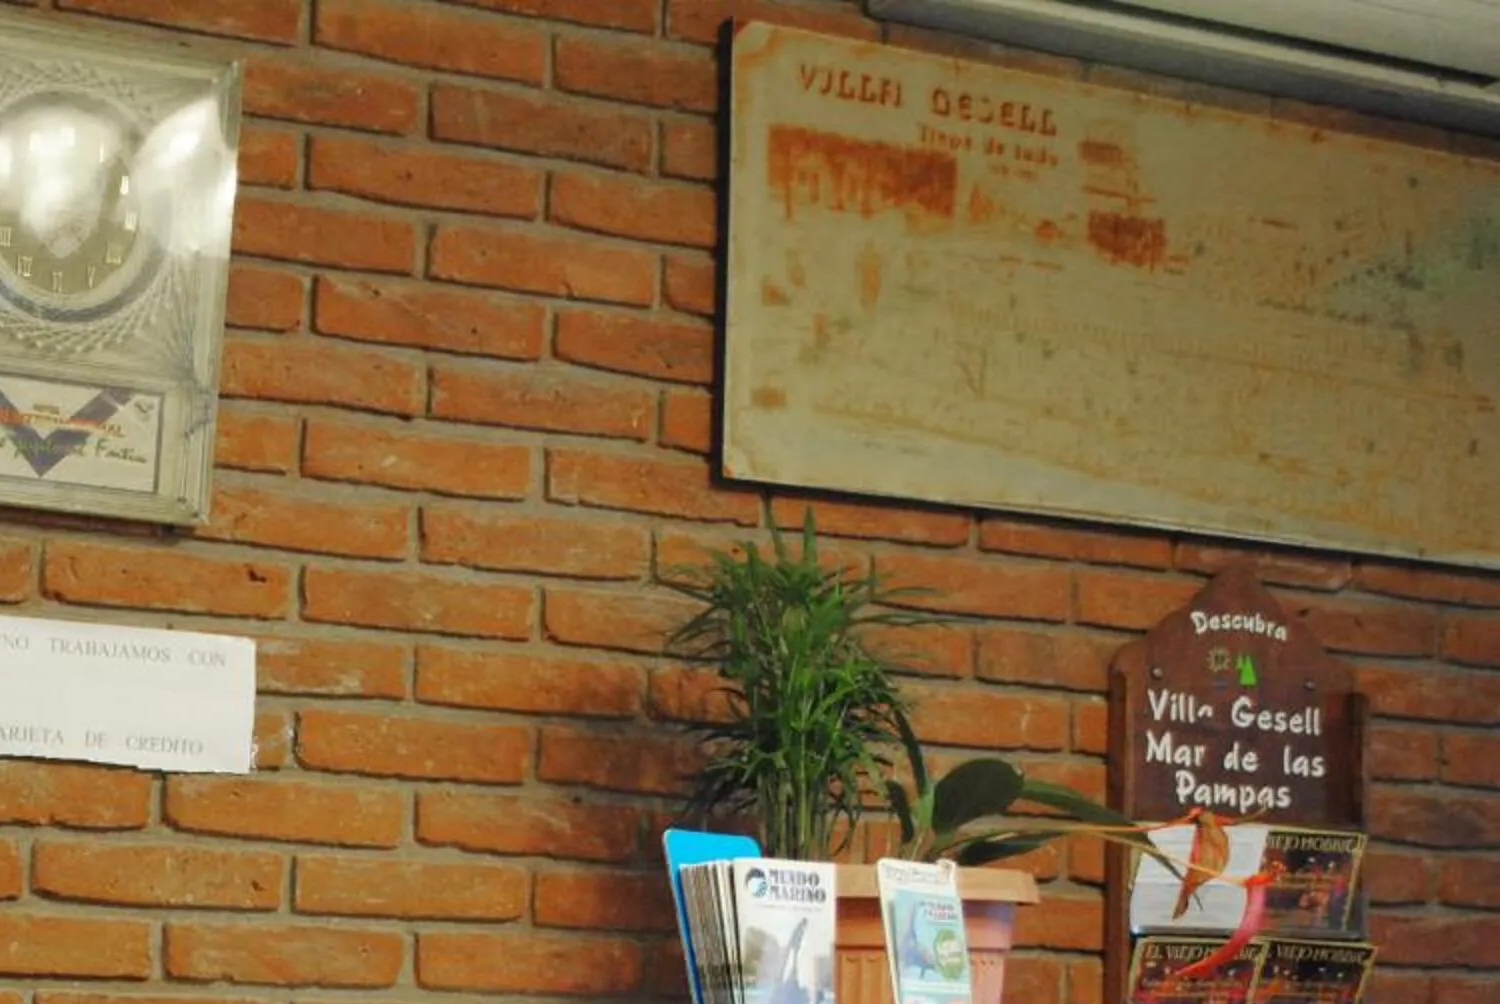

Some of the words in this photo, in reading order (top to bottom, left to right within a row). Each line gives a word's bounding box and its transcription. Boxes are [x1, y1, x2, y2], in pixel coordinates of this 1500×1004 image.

[1190, 610, 1288, 642] Descubra
[48, 636, 172, 664] TRABAJAMOS
[187, 650, 228, 668] CON
[1231, 695, 1323, 736] Gesell
[85, 730, 108, 748] DE
[125, 735, 204, 756] CREDITO
[1145, 730, 1205, 769] Mar
[1223, 741, 1261, 772] de
[1283, 745, 1326, 778] las
[1175, 769, 1292, 813] Pampas
[768, 867, 821, 887] MUNDO
[768, 885, 827, 904] MARINO
